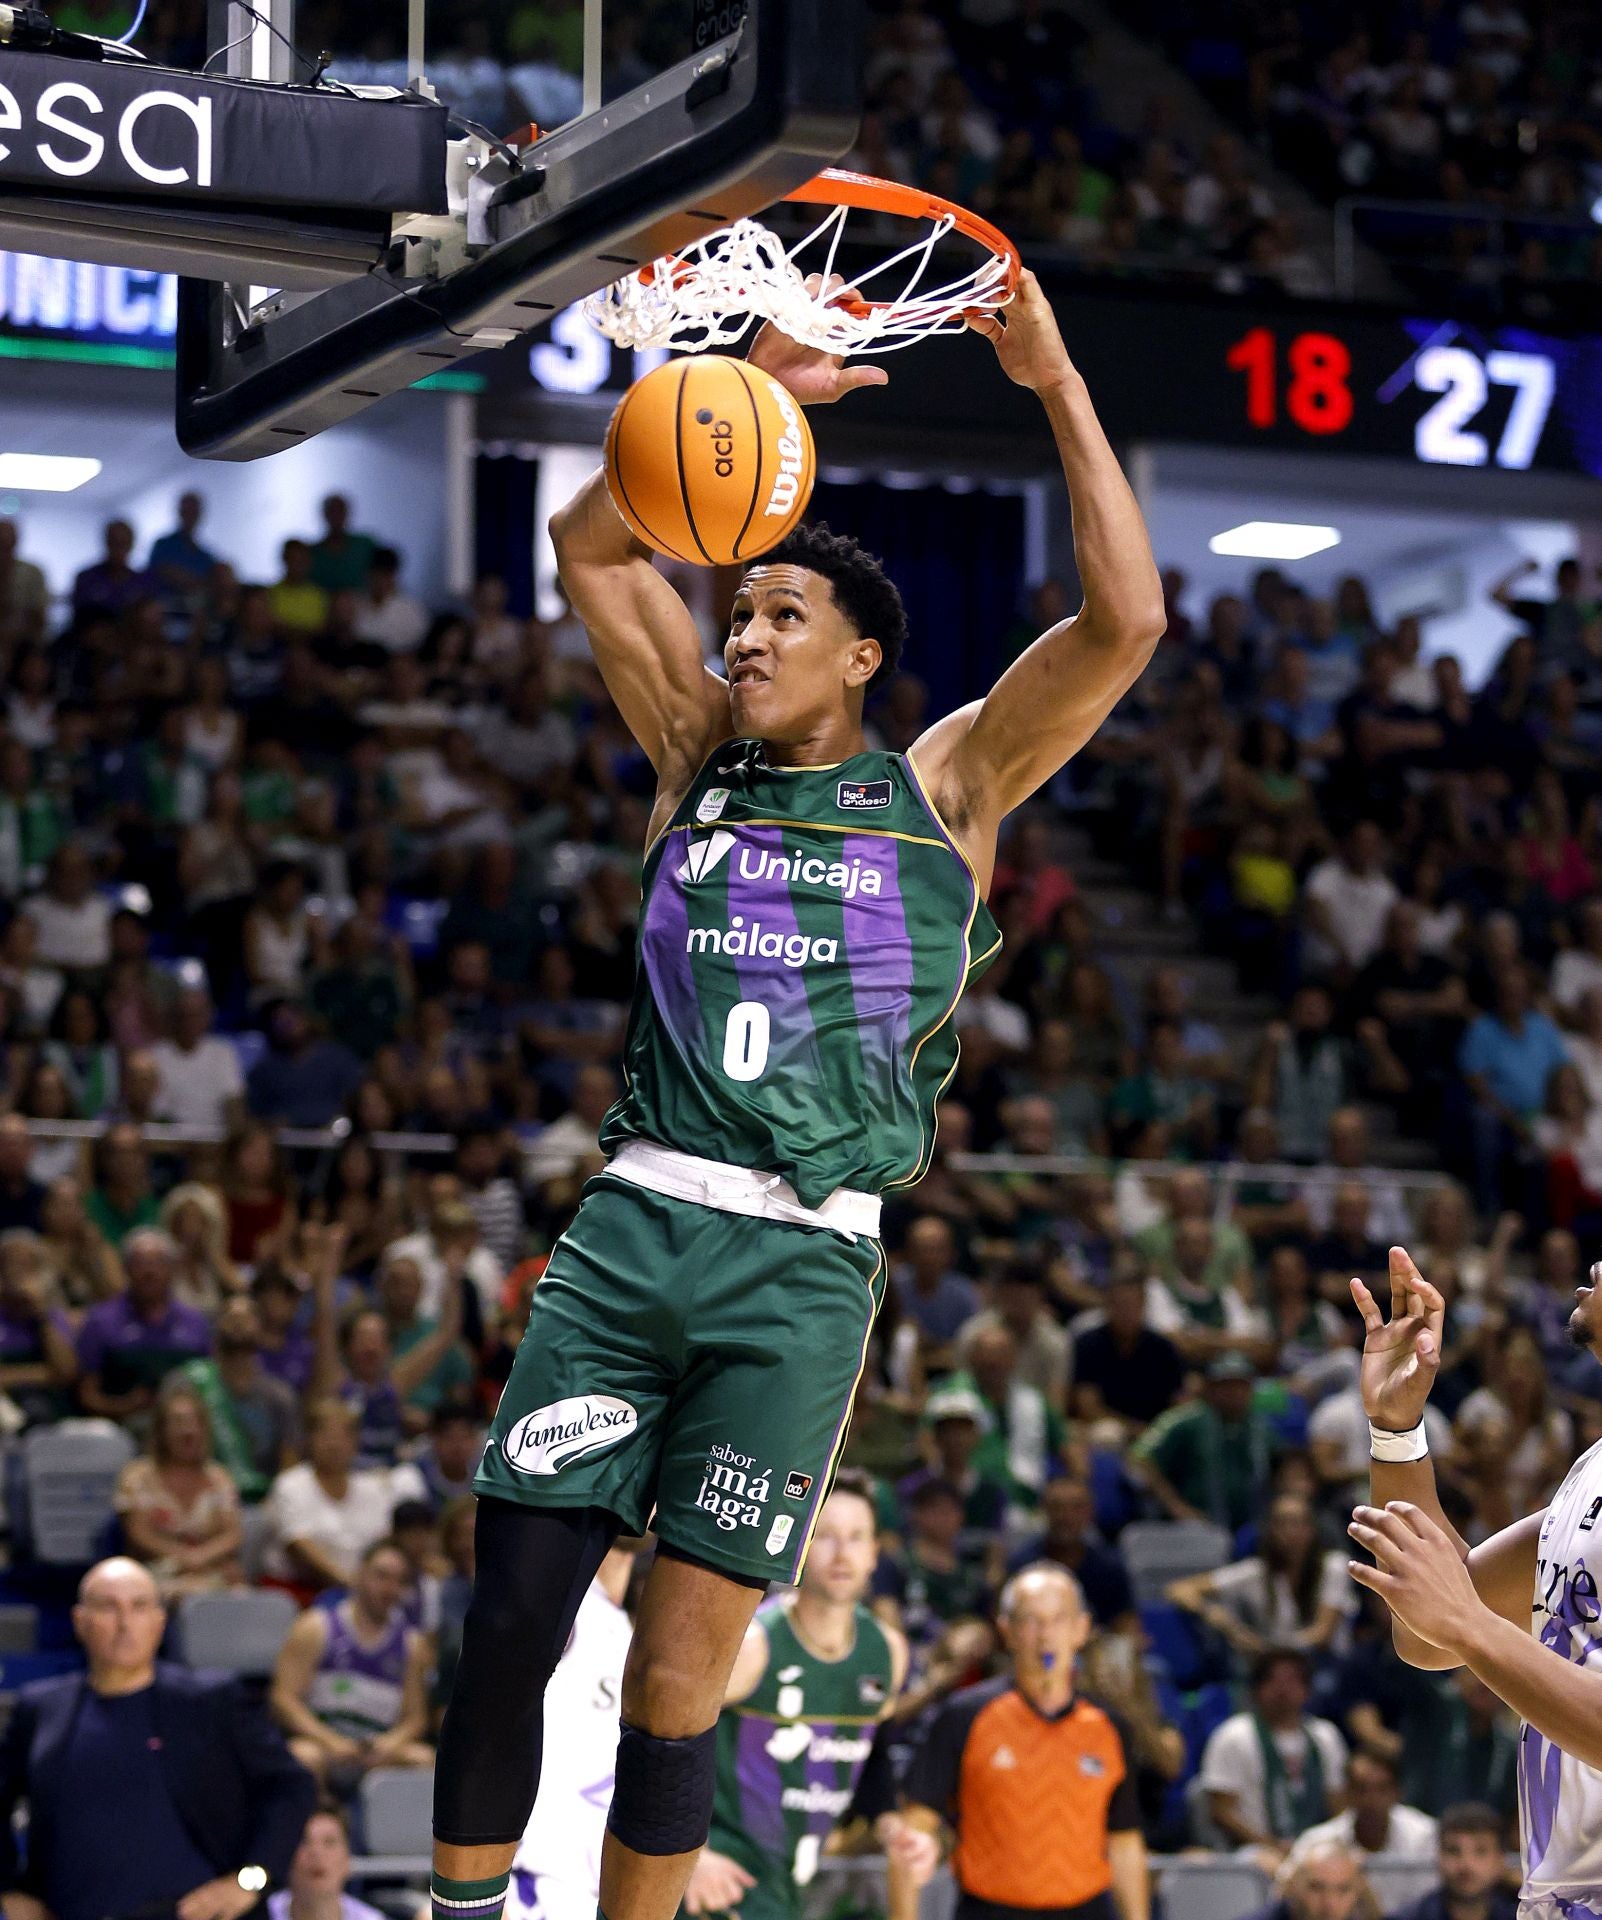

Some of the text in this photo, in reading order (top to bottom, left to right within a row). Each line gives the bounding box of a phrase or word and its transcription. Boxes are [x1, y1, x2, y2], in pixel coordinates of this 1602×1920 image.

[0, 81, 212, 187] sa
[0, 250, 178, 335] NIC
[1225, 326, 1355, 436] 18
[1414, 345, 1557, 471] 27
[710, 420, 733, 478] acb
[843, 790, 864, 800] liga
[843, 797, 888, 806] endesa
[739, 848, 882, 898] Unicaja
[722, 1001, 771, 1081] 0
[511, 1402, 630, 1460] famadesa
[709, 1443, 757, 1470] sabor
[694, 1476, 762, 1531] laga
